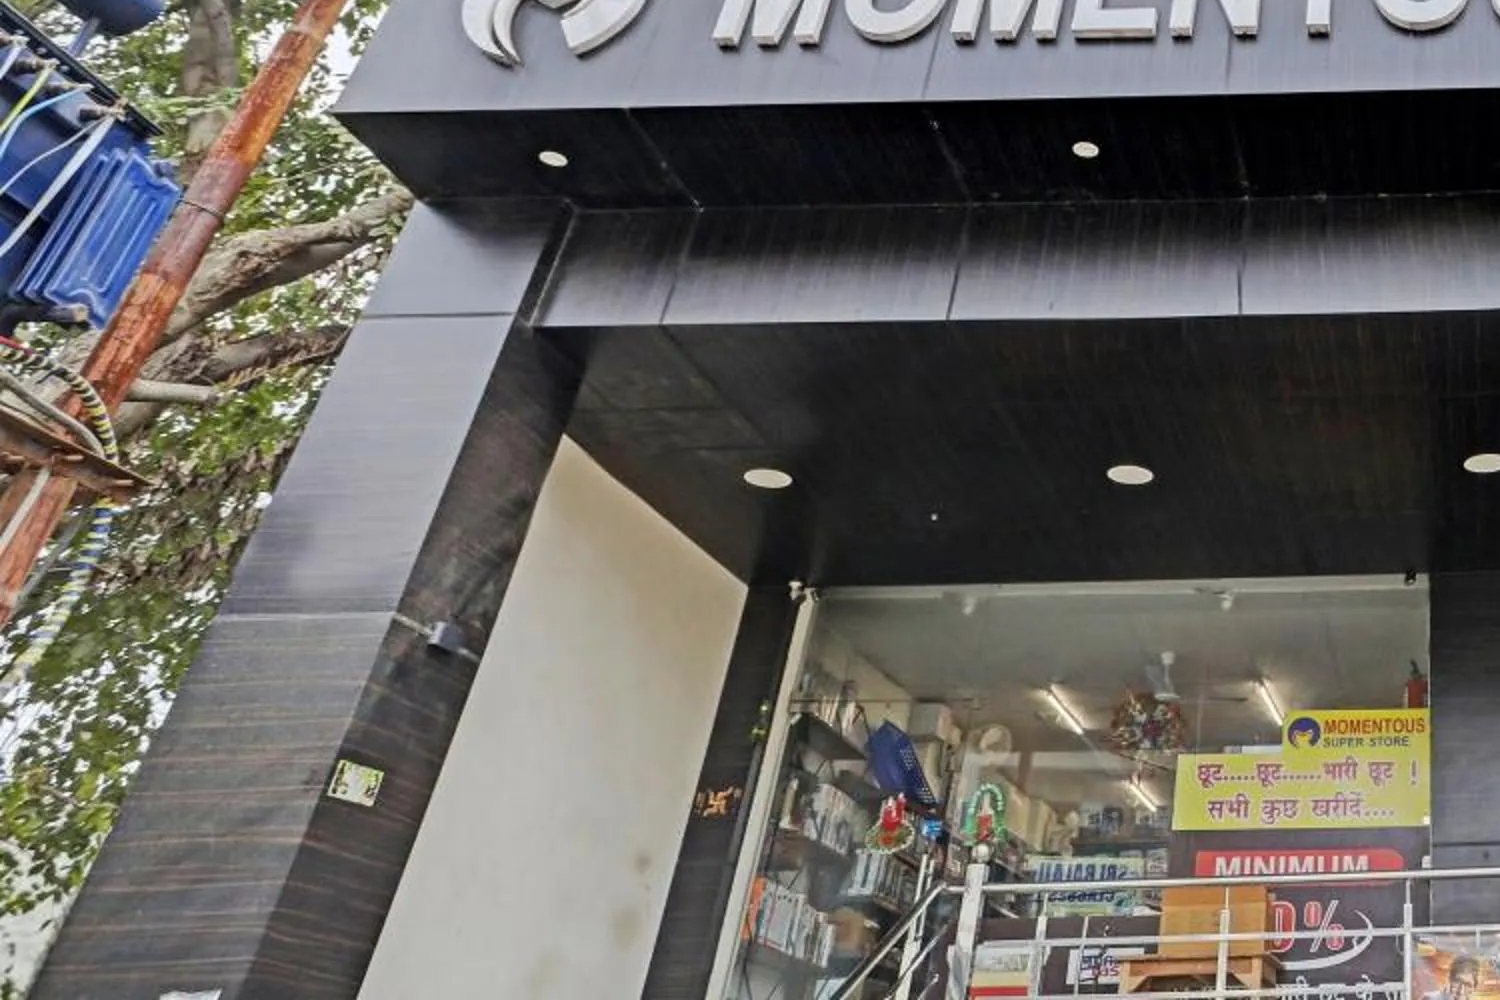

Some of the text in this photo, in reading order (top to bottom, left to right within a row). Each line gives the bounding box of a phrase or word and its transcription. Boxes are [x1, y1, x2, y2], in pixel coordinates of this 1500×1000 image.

[1323, 717, 1425, 735] MOMENTOUS
[1323, 735, 1410, 749] SUPER STORE
[1368, 762, 1395, 787] छूट
[1207, 793, 1251, 819] सभी
[1262, 799, 1299, 825] कुछ
[1214, 855, 1370, 877] MINIMUM
